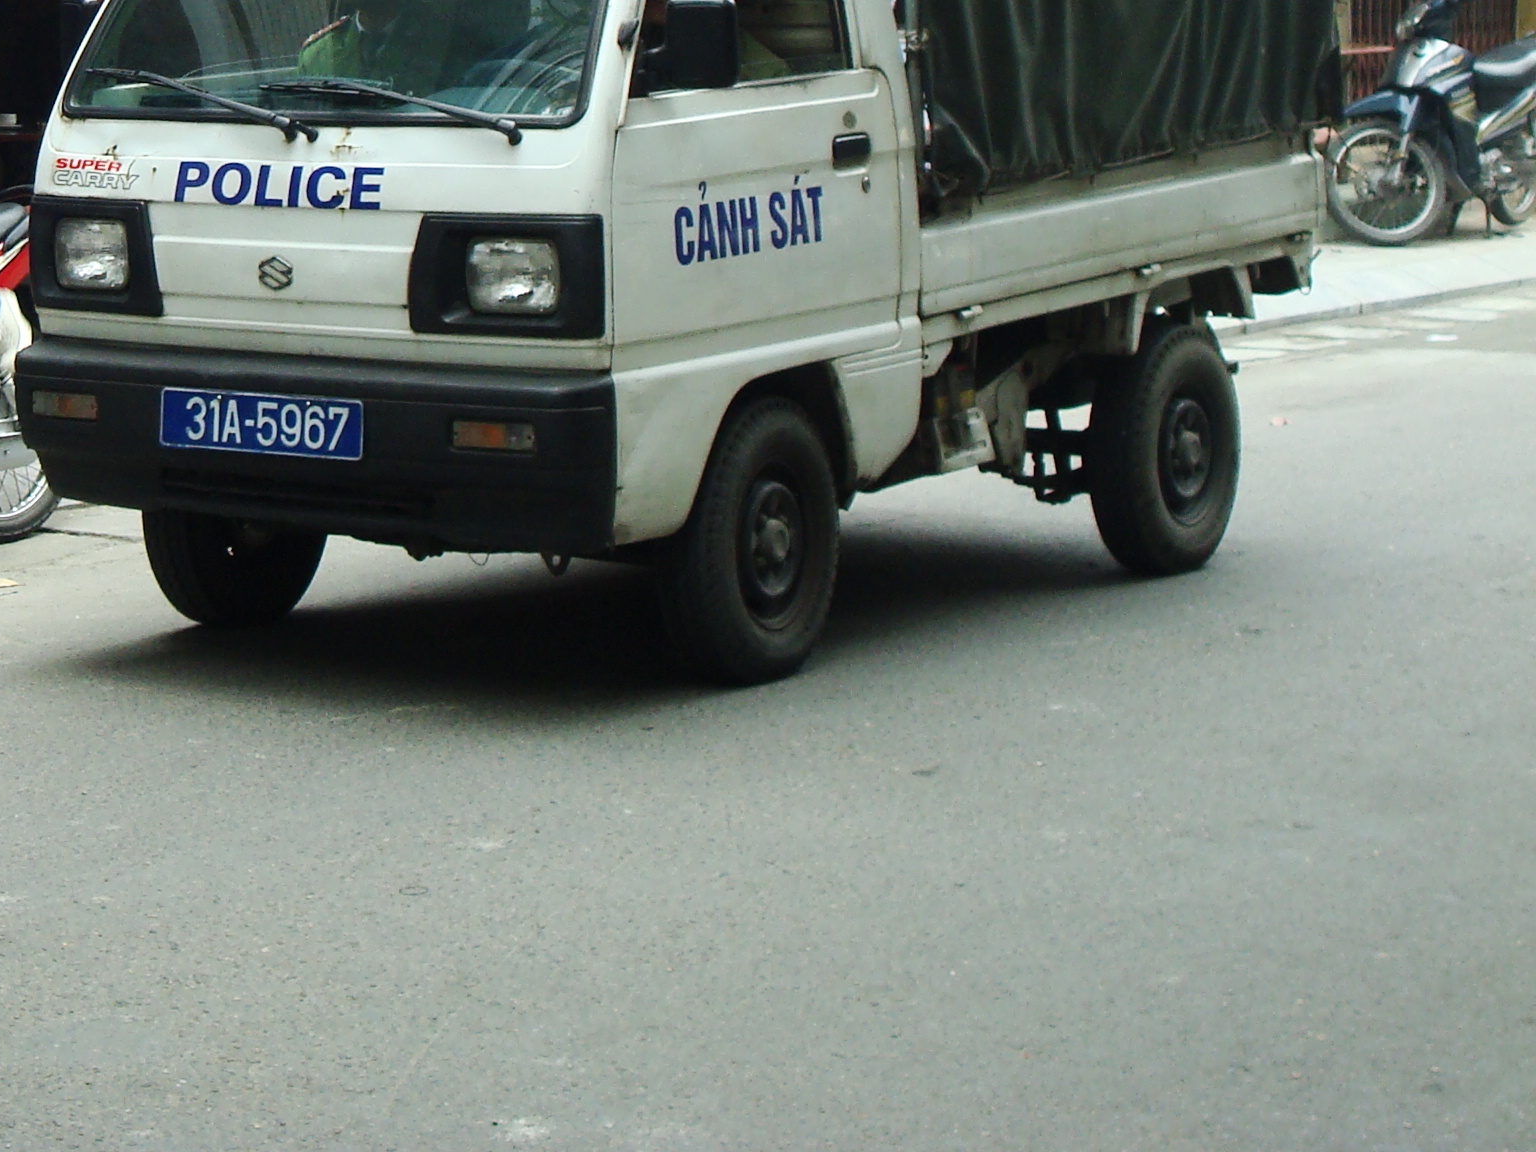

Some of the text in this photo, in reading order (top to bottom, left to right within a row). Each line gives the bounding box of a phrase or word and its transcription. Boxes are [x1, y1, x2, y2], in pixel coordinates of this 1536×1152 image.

[52, 169, 140, 190] CARRY
[55, 157, 123, 172] SUPER
[174, 161, 385, 211] POLICE
[674, 174, 824, 266] CẢNH SÁT
[185, 396, 350, 452] 31A-5967
